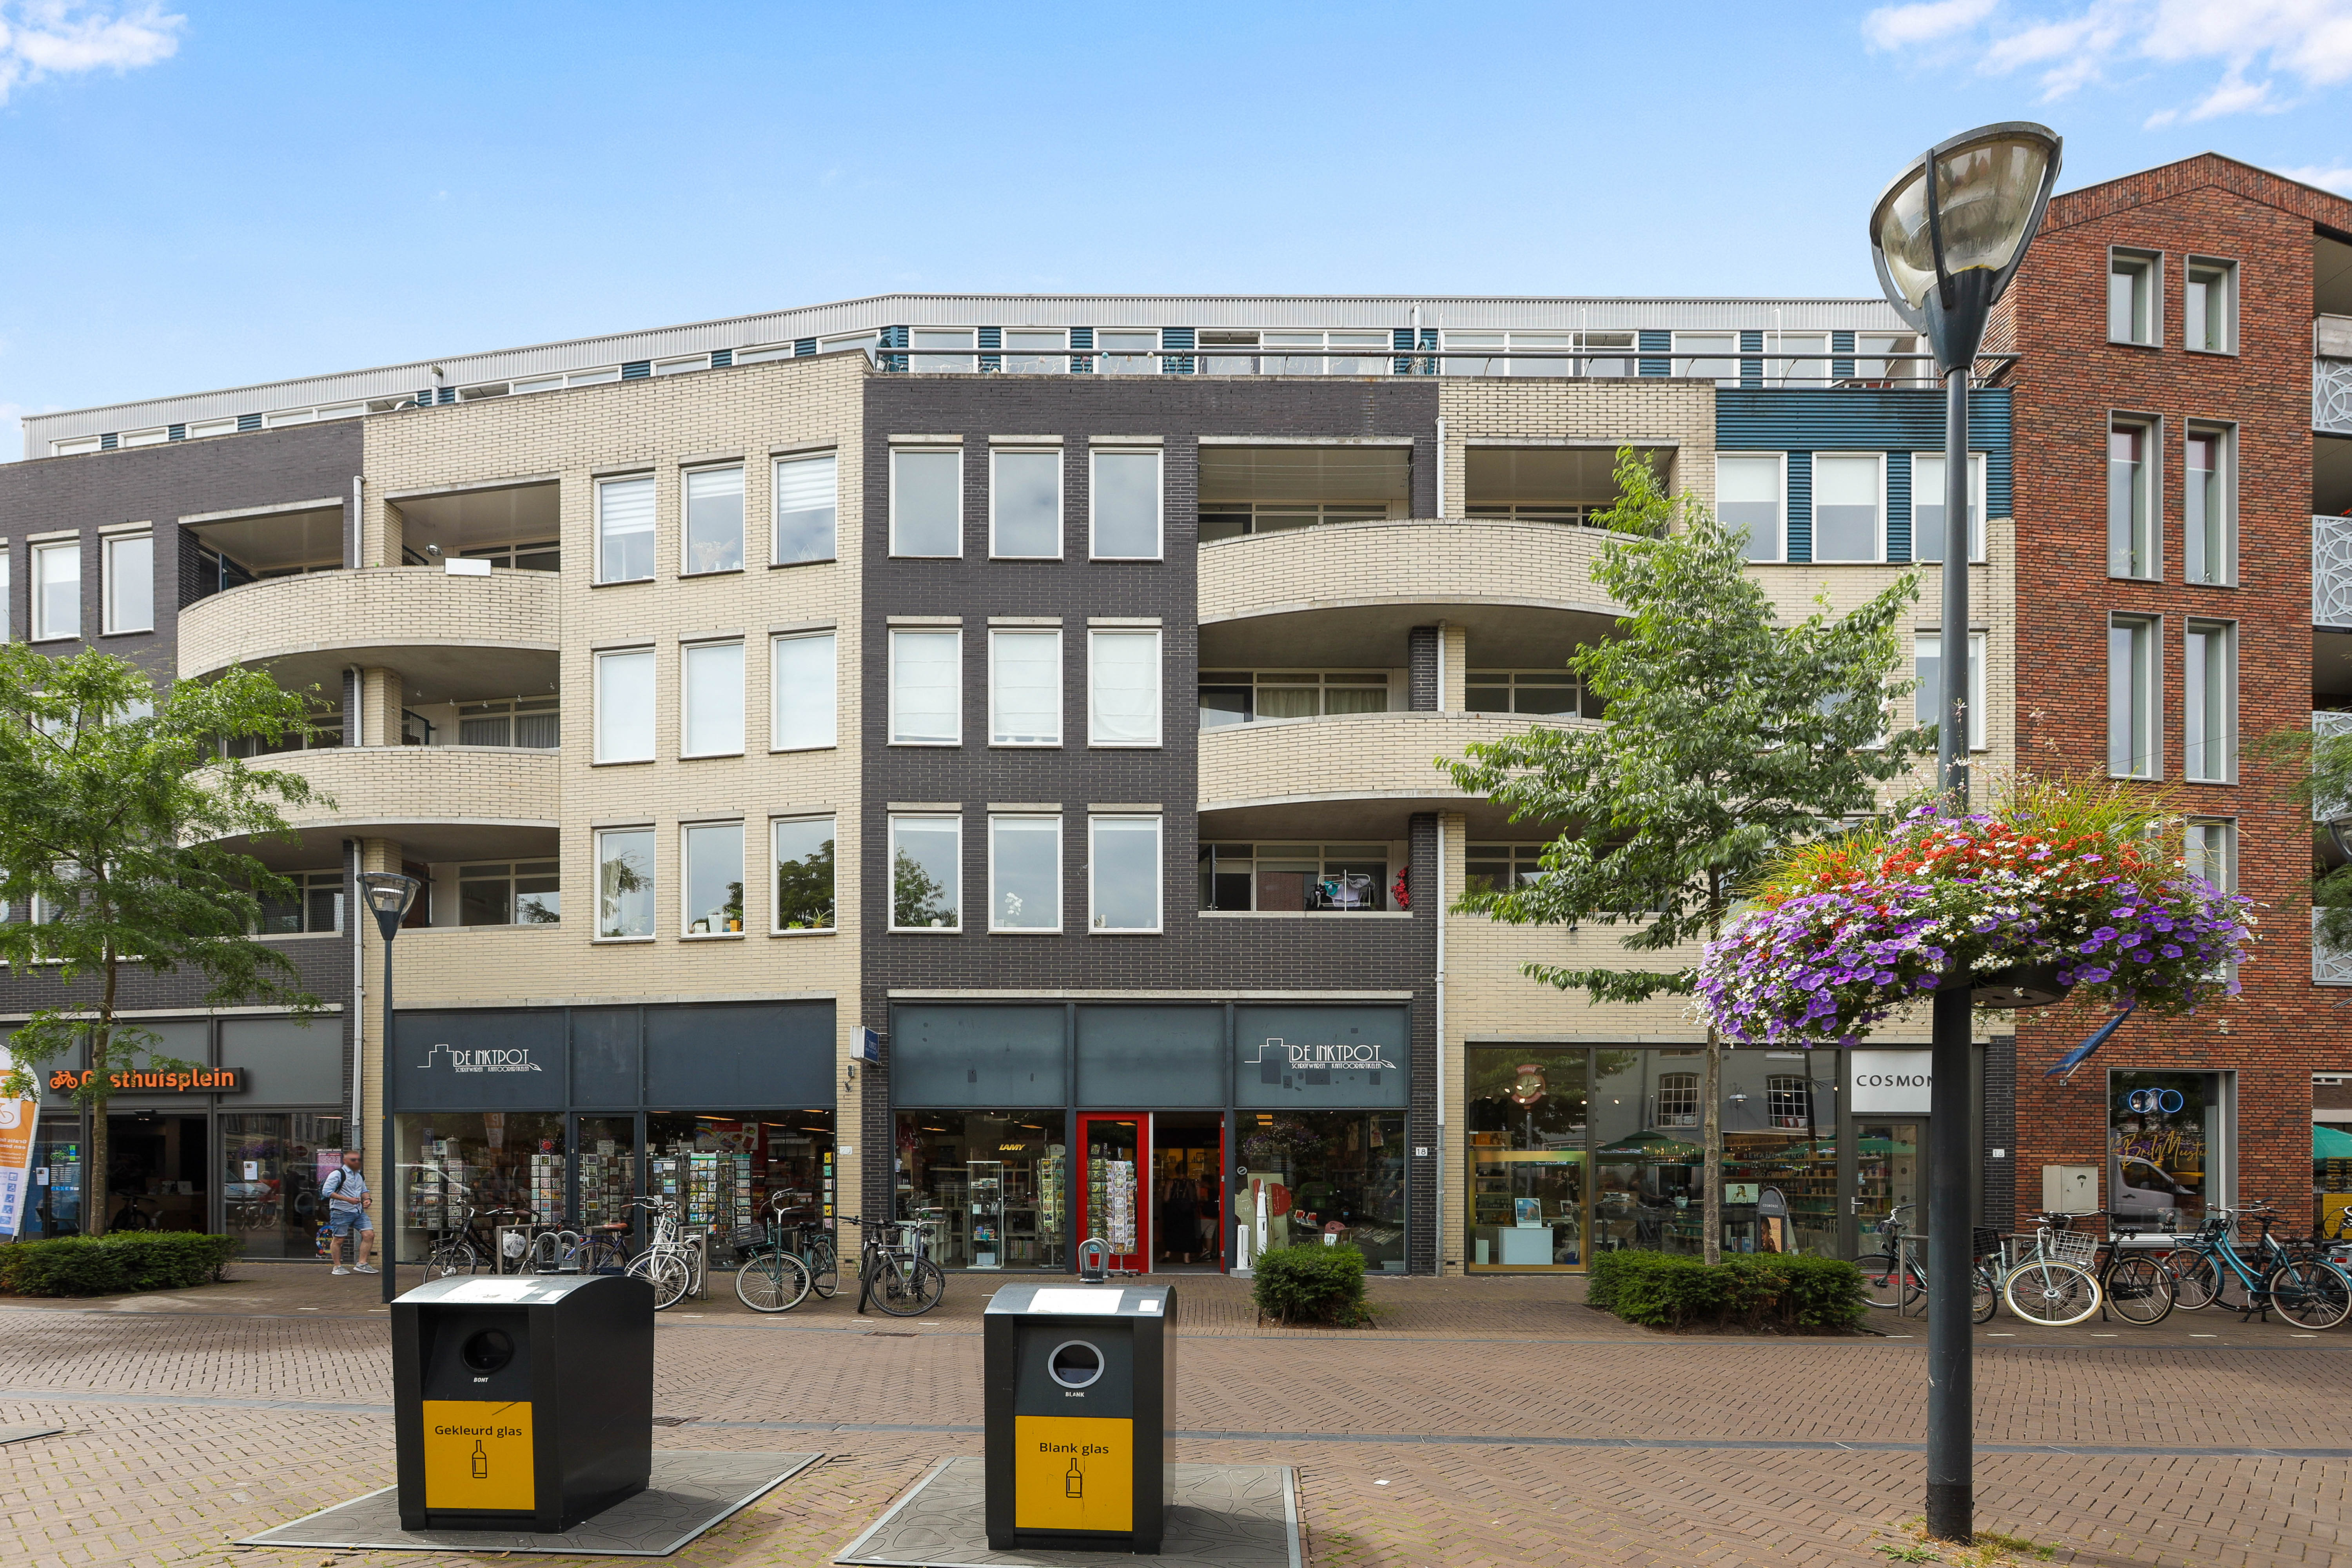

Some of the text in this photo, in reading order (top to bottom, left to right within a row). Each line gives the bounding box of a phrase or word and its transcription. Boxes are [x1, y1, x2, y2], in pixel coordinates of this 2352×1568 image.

[455, 1049, 529, 1065] DE INKTPOT
[1291, 1045, 1381, 1061] DE INKTPOT
[82, 1068, 234, 1091] Gsthuisplein
[435, 1425, 522, 1438] Gekleurd glas
[1040, 1443, 1109, 1456] Blank glas
